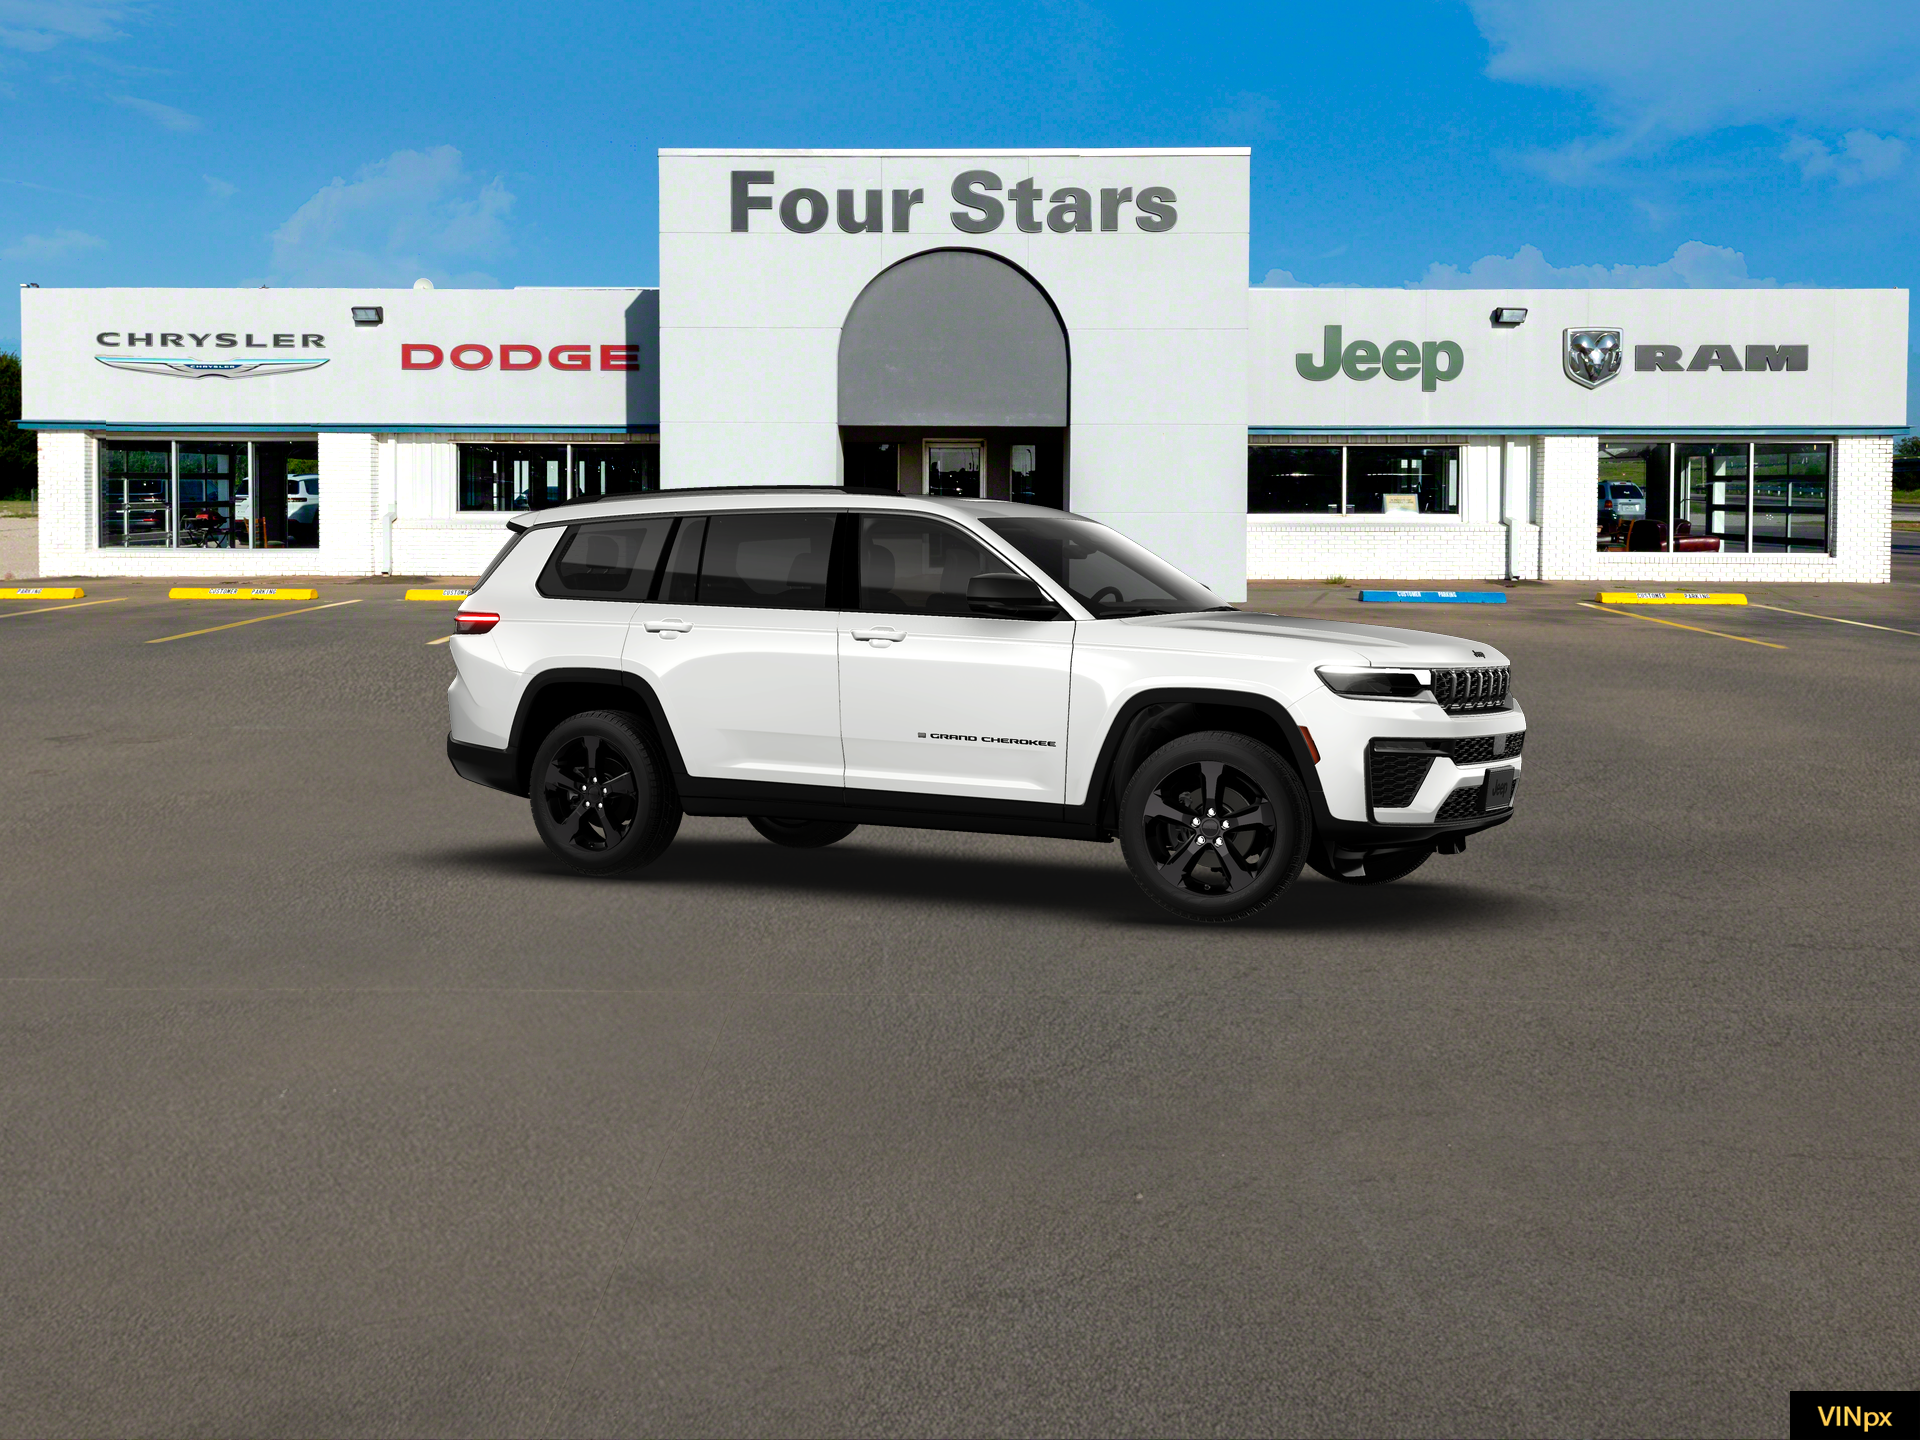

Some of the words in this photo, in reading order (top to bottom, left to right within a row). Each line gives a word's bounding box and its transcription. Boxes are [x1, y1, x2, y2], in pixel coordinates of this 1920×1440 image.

[730, 170, 924, 234] Four
[950, 169, 1178, 234] Stars
[96, 332, 326, 348] CHRYSLER
[401, 343, 640, 371] DODGE
[1296, 325, 1464, 392] Jeep
[1635, 344, 1809, 372] RAM
[930, 733, 978, 742] GRAND
[981, 736, 1056, 747] CHEROKEE
[1492, 779, 1508, 798] Jeep
